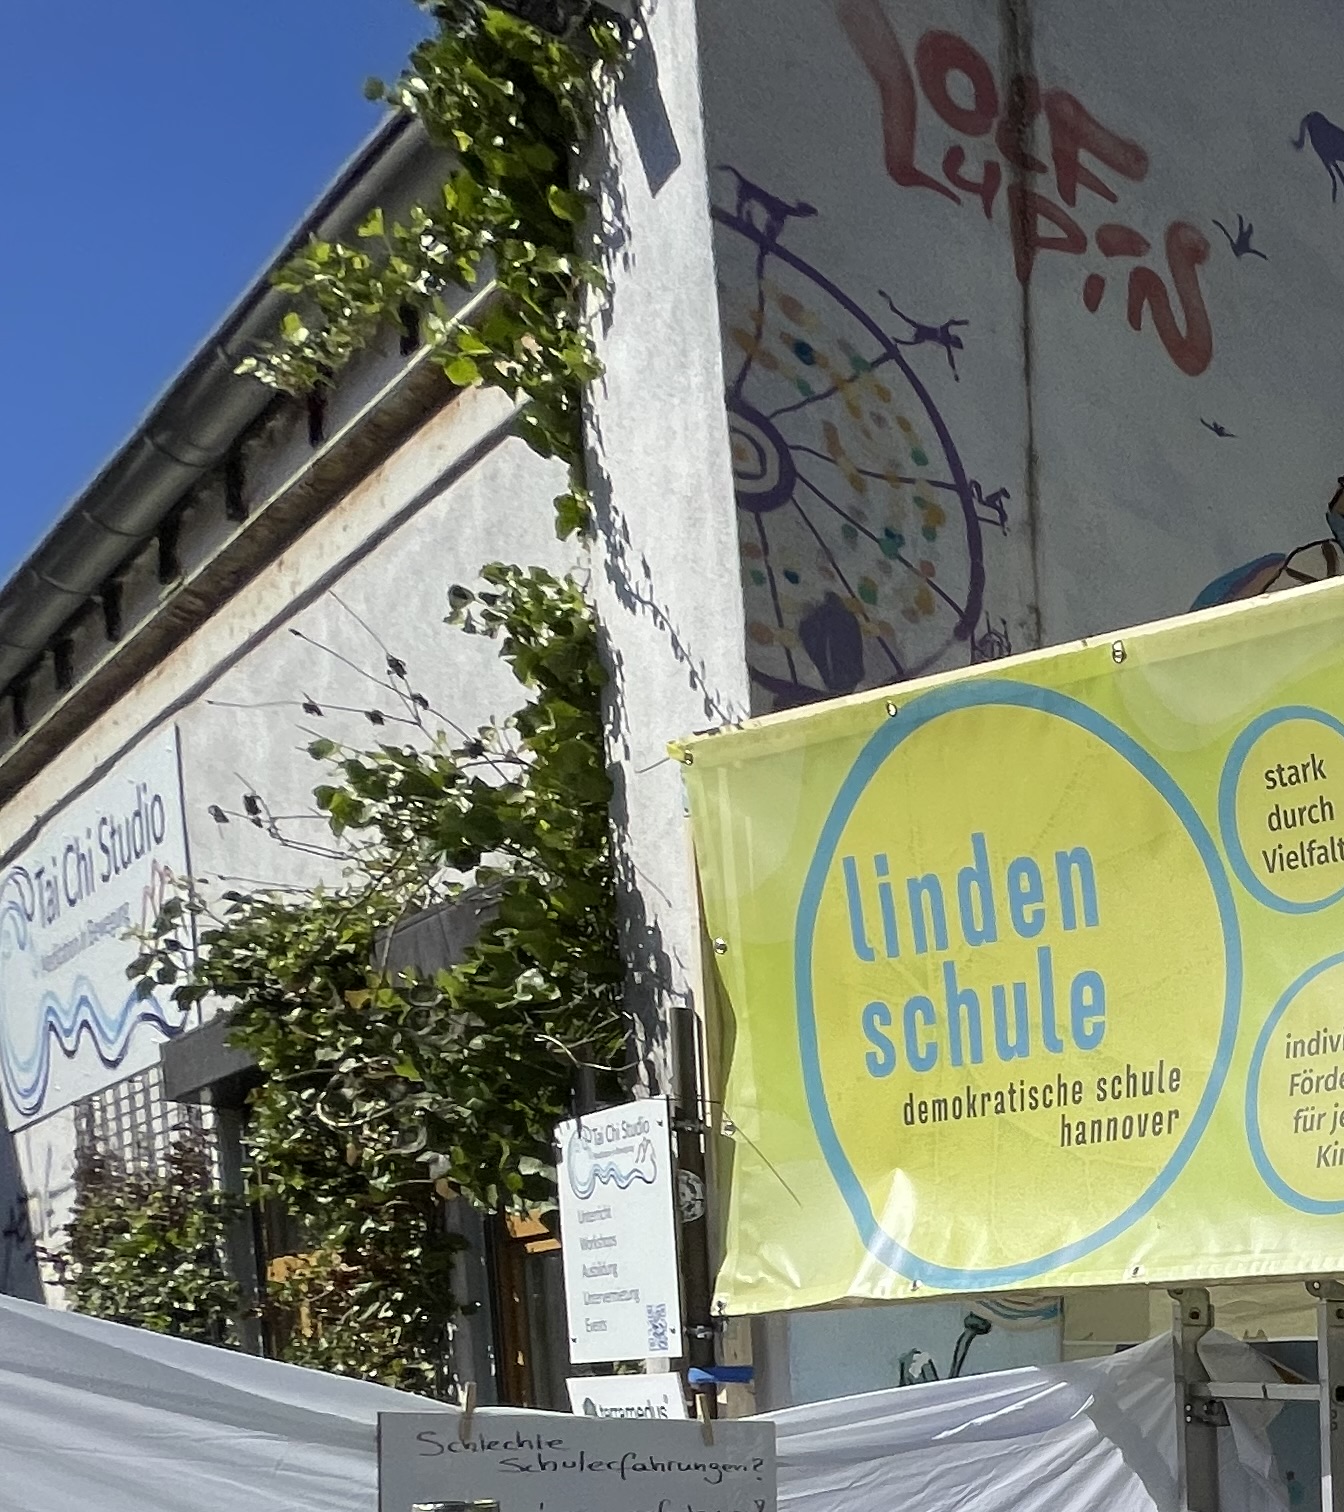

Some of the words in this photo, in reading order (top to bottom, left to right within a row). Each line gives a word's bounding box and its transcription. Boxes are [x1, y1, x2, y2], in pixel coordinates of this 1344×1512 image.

[1264, 754, 1327, 790] stark
[1267, 797, 1335, 833] durch
[35, 855, 61, 929] Tai
[63, 827, 96, 908] Chi
[98, 782, 166, 883] Studio
[842, 832, 1099, 961] linden
[864, 947, 1106, 1079] schule
[903, 1072, 1083, 1127] demokratische
[1096, 1060, 1182, 1103] schule
[1059, 1106, 1180, 1148] hannover
[1292, 1104, 1325, 1135] für
[416, 1430, 567, 1456] Schlechte
[498, 1450, 764, 1485] Schulerfahrungen?
